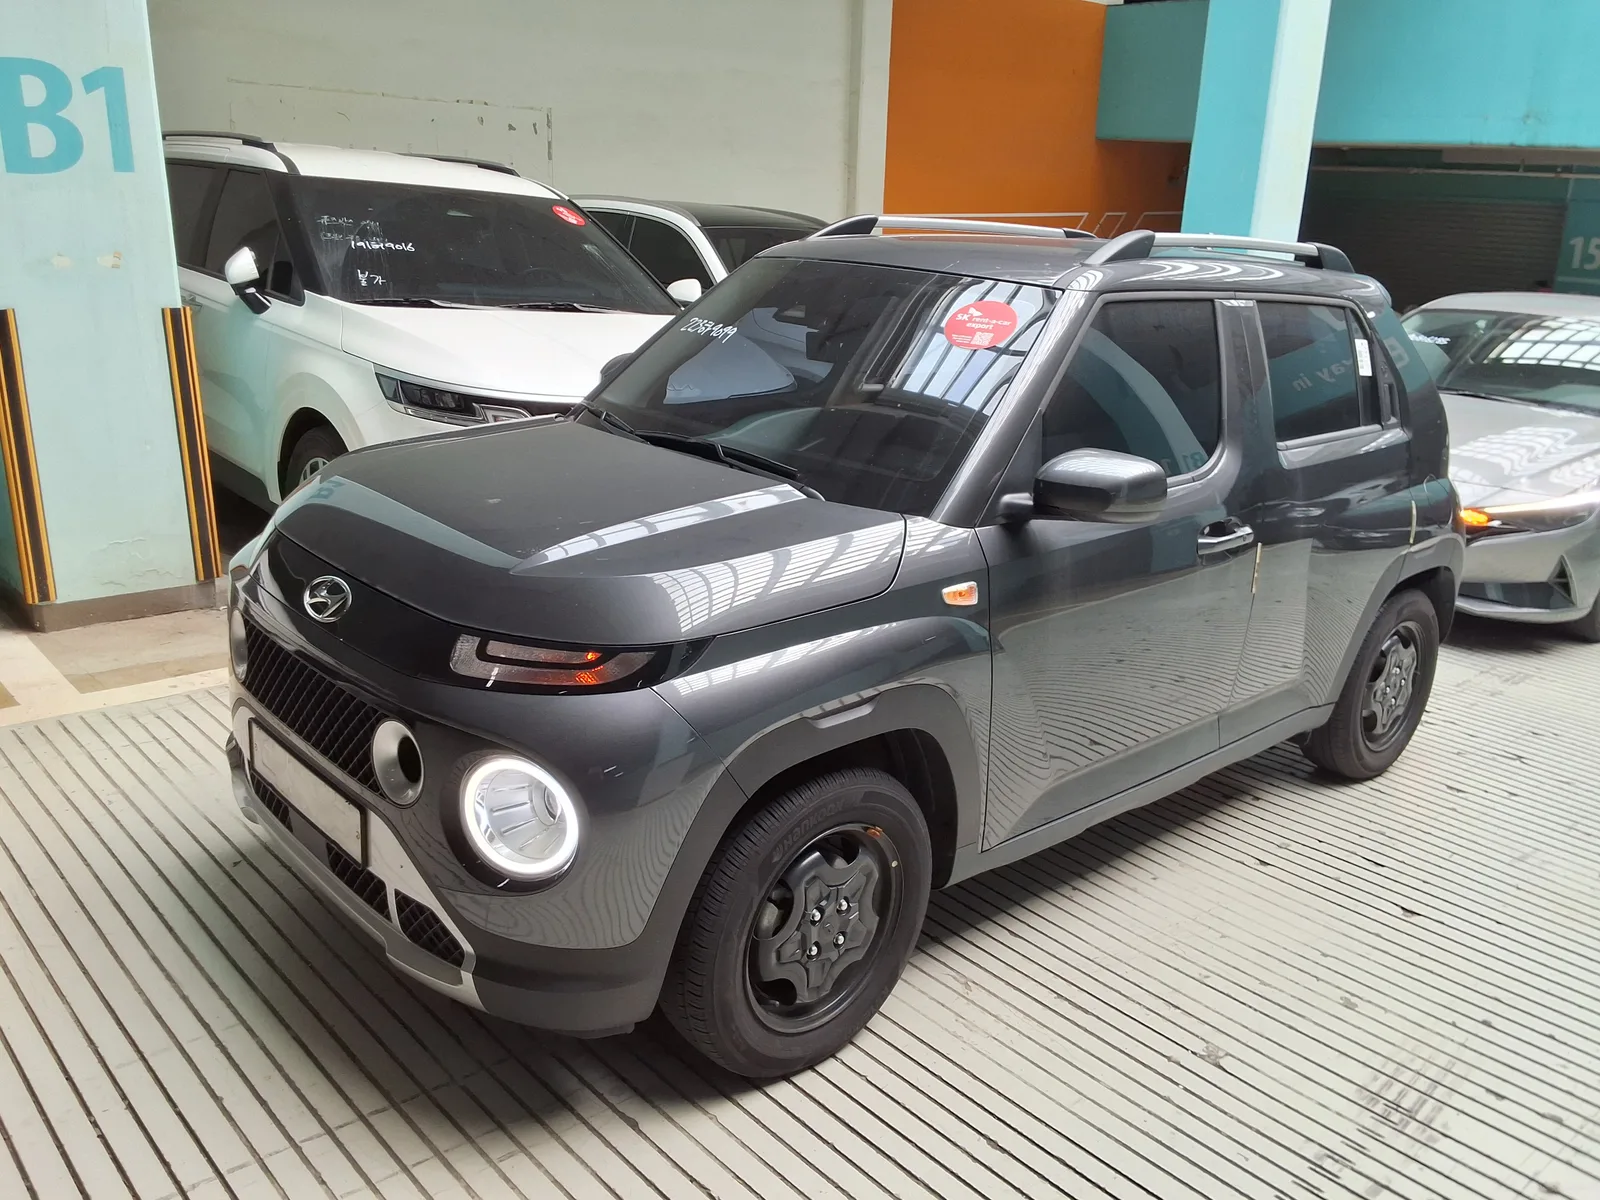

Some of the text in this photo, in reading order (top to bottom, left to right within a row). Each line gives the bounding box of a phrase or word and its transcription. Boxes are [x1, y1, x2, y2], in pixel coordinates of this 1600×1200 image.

[0, 56, 135, 174] B1
[955, 313, 1012, 326] SK rent-a-car
[966, 322, 994, 330] export
